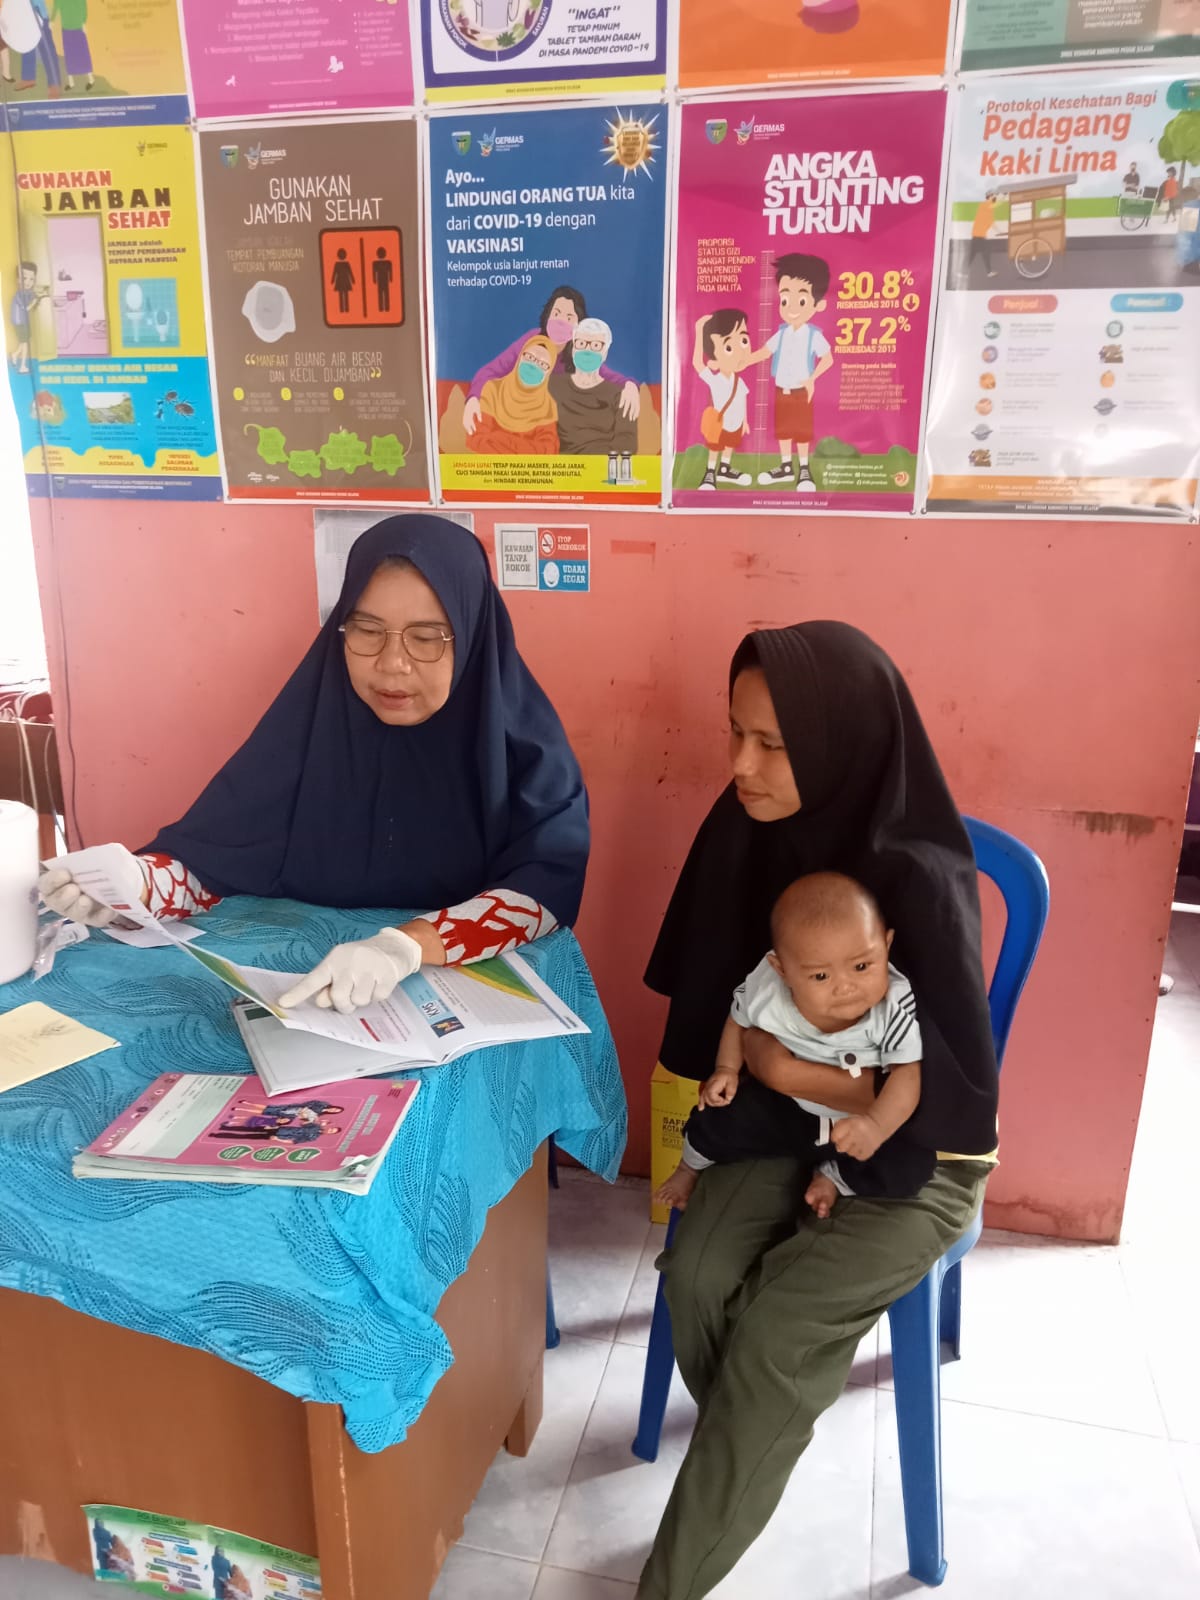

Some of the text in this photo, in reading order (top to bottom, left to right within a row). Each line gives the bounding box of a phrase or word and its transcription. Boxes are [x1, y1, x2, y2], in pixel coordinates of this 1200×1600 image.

[531, 6, 549, 36] SAYURAN
[567, 22, 620, 33] TETAP MINUM
[547, 32, 641, 46] TABLET TAMBAH DARAH
[538, 50, 547, 58] DI
[548, 48, 570, 57] MASA
[572, 46, 608, 55] PANDEMI
[986, 90, 1157, 113] Protokol Kesehatan Bagi
[754, 123, 784, 133] GERMAS
[983, 111, 1132, 145] Pedagang
[495, 136, 524, 144] GERMAS
[764, 150, 877, 181] ANGKA
[980, 145, 1118, 177] Kaki Lima
[17, 170, 112, 190] GUNAKAN
[445, 169, 484, 187] Ayo...
[269, 175, 351, 200] GUNAKAN
[446, 184, 635, 207] LINDUNGI ORANG TUA kita
[763, 175, 924, 207] STUNTING
[43, 188, 171, 212] JAMBAN
[243, 198, 383, 225] JAMBAN SEHAT
[108, 210, 171, 230] SEHAT
[446, 212, 596, 231] dari COVID-19 dengan
[762, 205, 871, 235] TURUN
[447, 237, 524, 253] VAKSINASI
[698, 239, 735, 247] PROPORSI
[698, 247, 741, 256] STATUS GIZI
[447, 258, 569, 273] Kelompok usia lanjut rentan
[697, 255, 756, 265] SANGAT PENDEK
[697, 265, 742, 274] DAN PENDEK
[448, 276, 532, 289] terhadap COVID-19
[696, 274, 738, 283] (STUNTING)
[837, 268, 914, 299] 30.8%
[696, 283, 742, 292] PADA BALITA
[837, 300, 900, 309] RISKESDAS 2018
[834, 315, 911, 345] 37.2%
[834, 345, 897, 354] RISKESDAS 2013
[294, 352, 325, 367] BUANG
[331, 351, 346, 366] AIR
[352, 351, 382, 366] BESAR
[269, 369, 285, 383] DAN
[290, 367, 318, 382] KECIL
[505, 554, 527, 562] TANPA
[506, 563, 530, 572] ROKOK
[562, 565, 586, 573] UDARA
[563, 575, 586, 583] SEGAR
